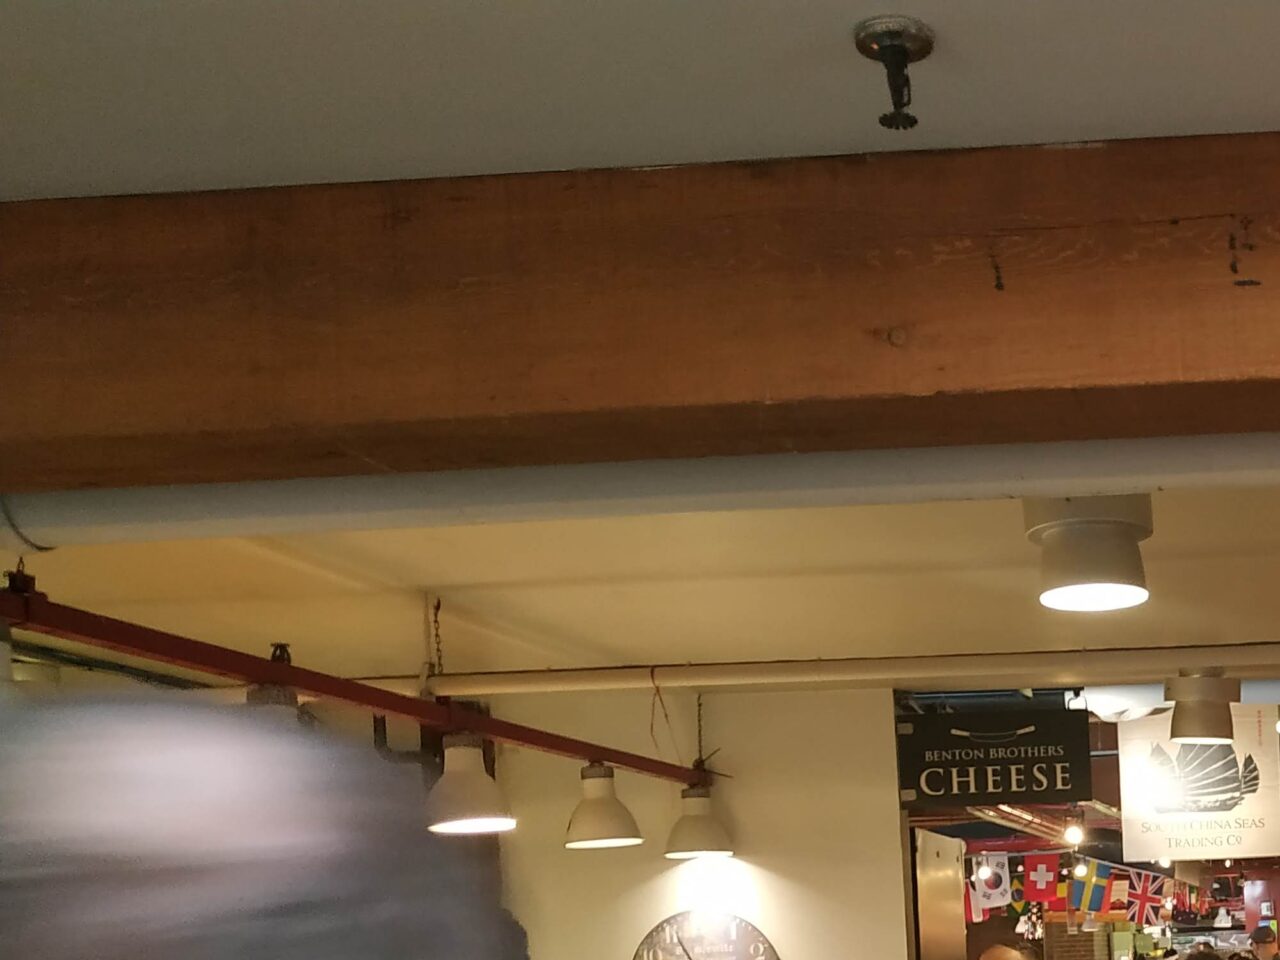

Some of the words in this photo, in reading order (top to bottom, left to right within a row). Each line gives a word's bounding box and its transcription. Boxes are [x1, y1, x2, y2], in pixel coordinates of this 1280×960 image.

[925, 748, 984, 762] BENTON
[989, 745, 1064, 759] BROTHERS
[919, 762, 1072, 796] CHEESE
[1190, 819, 1232, 831] CHINA
[1234, 817, 1265, 830] SEAS
[1165, 836, 1223, 849] TRADING
[749, 943, 766, 960] 2
